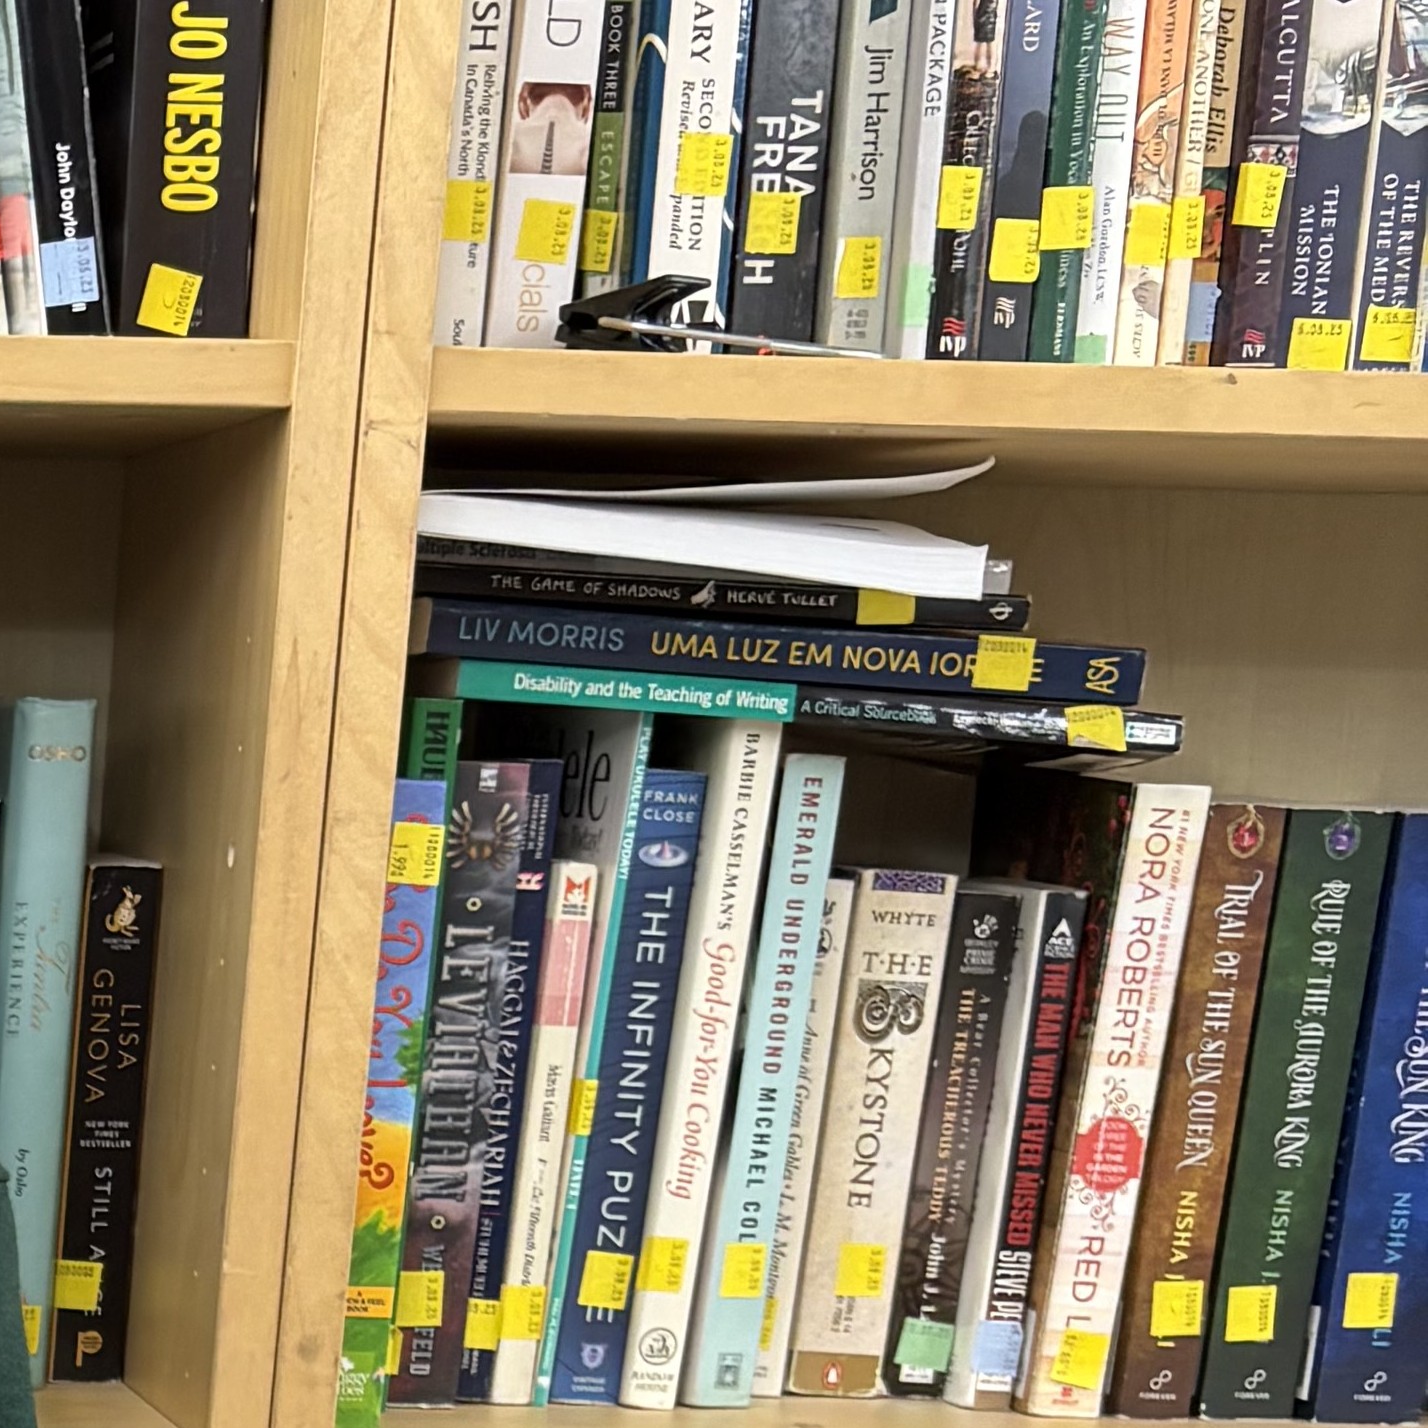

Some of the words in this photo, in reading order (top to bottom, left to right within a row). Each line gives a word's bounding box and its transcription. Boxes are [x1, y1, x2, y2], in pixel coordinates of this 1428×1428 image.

[170, 0, 229, 60] JO
[608, 5, 623, 55] BOOK
[865, 45, 893, 87] Jim
[924, 12, 945, 117] PACKAGE
[1211, 6, 1235, 95] Deborah
[603, 60, 620, 109] THREE
[163, 73, 225, 212] NESBO
[858, 93, 890, 201] Harrison
[1206, 101, 1227, 154] Ellis
[597, 130, 614, 203] ESCAPE
[1323, 184, 1339, 225] THE
[1291, 205, 1315, 296] MISSION
[1312, 236, 1334, 315] IONIAN
[460, 617, 501, 642] LIV
[508, 623, 624, 651] MORRIS
[652, 632, 718, 661] UMA
[727, 637, 780, 663] LUZ
[789, 642, 834, 667] EM
[843, 645, 921, 674] NOVA
[514, 673, 581, 696] Disability
[586, 677, 611, 698] and
[617, 679, 642, 698] the
[647, 682, 711, 708] Teaching
[716, 687, 733, 706] of
[738, 689, 789, 714] Writing
[800, 698, 811, 712] A
[813, 699, 859, 719] Critical
[863, 703, 936, 725] Sourcebook
[29, 744, 87, 762] OSHO
[736, 732, 761, 801] BARBIE
[644, 808, 694, 823] CLOSE
[645, 790, 698, 804] FRANK
[786, 776, 823, 885] EMERALD
[717, 805, 749, 931] CASSELMAN'S
[1131, 806, 1177, 903] NORA
[635, 887, 673, 964] THE
[871, 910, 936, 929] WHYTE
[4, 902, 28, 1039] EXPERIENCE
[763, 897, 806, 1074] UNDERGROUND
[1107, 913, 1159, 1068] ROBERTS
[84, 968, 115, 1104] GENOVA
[117, 1004, 142, 1069] LISA
[609, 980, 660, 1156] INFINITY
[665, 1103, 711, 1199] Cooking
[748, 1086, 779, 1190] MICHAEL
[90, 1167, 113, 1233] STILL
[1170, 1191, 1197, 1265] NISHA
[1265, 1191, 1293, 1264] NISHA
[1383, 1192, 1410, 1265] NISHA
[1070, 1236, 1105, 1302] RED
